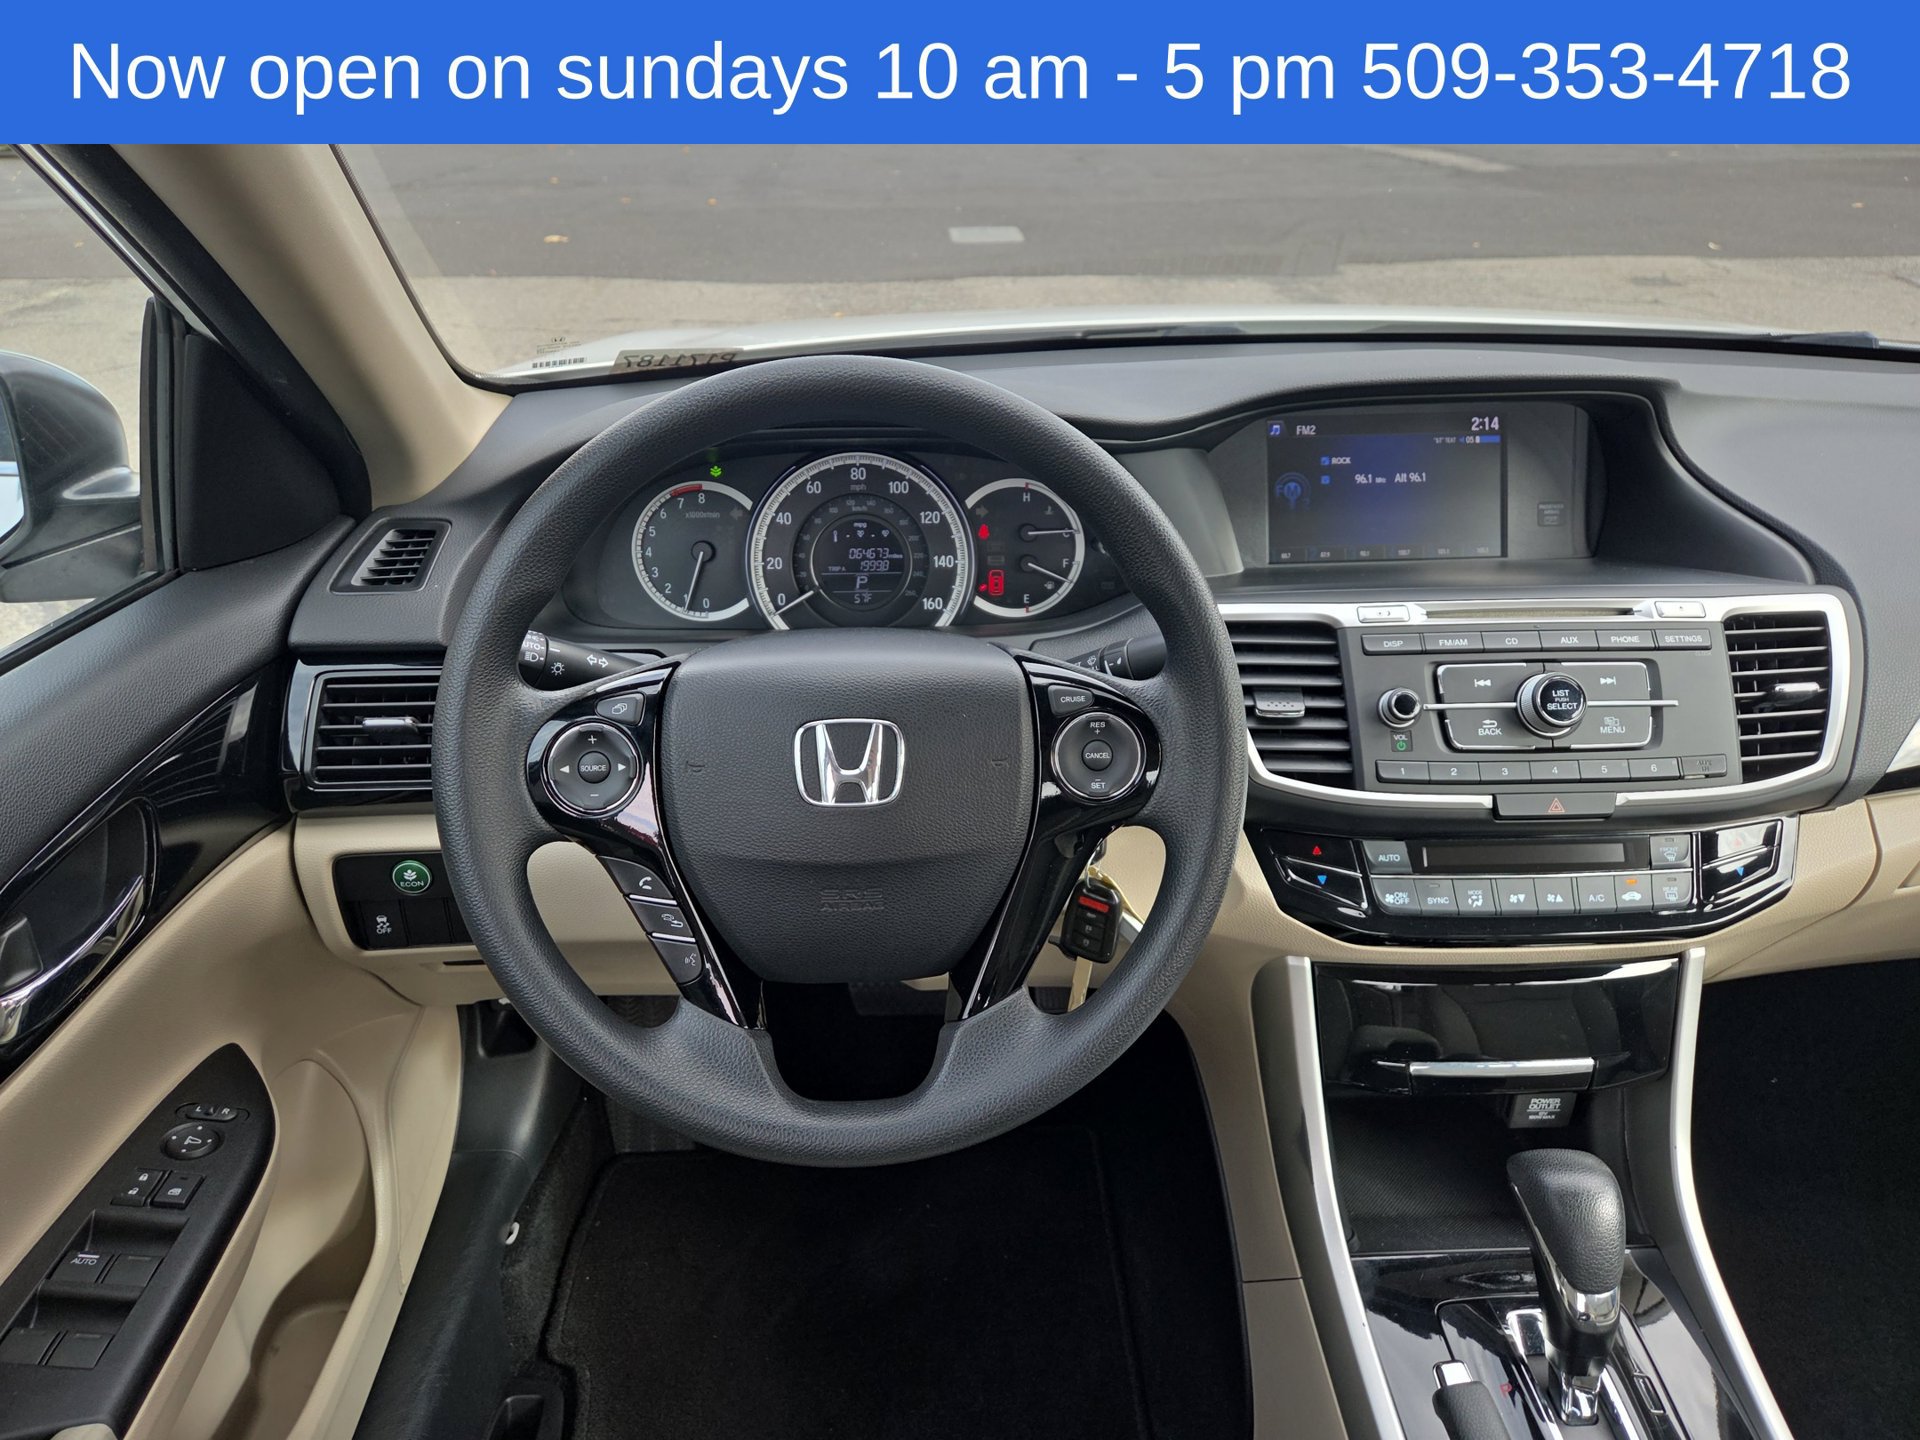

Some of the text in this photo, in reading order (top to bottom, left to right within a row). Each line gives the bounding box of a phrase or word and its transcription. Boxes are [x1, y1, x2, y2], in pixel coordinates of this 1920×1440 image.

[1296, 416, 1499, 436] FM2 2:14
[850, 468, 866, 480] 80
[1355, 474, 1372, 484] 96.1
[1395, 473, 1407, 483] Alt
[1409, 472, 1426, 482] 96.1
[806, 481, 822, 494] 60
[850, 484, 867, 492] mph
[888, 481, 909, 493] 100
[698, 493, 706, 504] 8
[1023, 493, 1030, 502] H
[677, 498, 684, 508] 7
[660, 509, 667, 519] 6
[776, 512, 792, 524] 40
[920, 511, 940, 524] 120
[649, 526, 656, 537] 5
[645, 547, 652, 557] 4
[849, 548, 889, 559] 064673
[766, 558, 782, 570] 20
[933, 555, 954, 568] 140
[1063, 559, 1069, 568] F
[651, 567, 659, 577] 3
[856, 576, 868, 588] P
[664, 583, 672, 593] 2
[703, 598, 710, 608] 0
[778, 594, 786, 606] 0
[923, 597, 943, 610] 160
[1023, 594, 1030, 604] E
[1383, 640, 1403, 648] DISP
[1439, 639, 1468, 647] FM/AM
[1505, 637, 1519, 645] CD
[1560, 636, 1579, 644] AUX
[1665, 635, 1702, 643] SETTINGS
[1547, 702, 1577, 710] SELECT
[1478, 728, 1502, 736] BACK
[1600, 726, 1626, 734] MENU
[1552, 766, 1558, 774] 4
[1601, 765, 1608, 773] 5
[1651, 764, 1658, 772] 6
[1378, 854, 1400, 862] AUTO
[1589, 894, 1605, 902] A/C
[70, 1258, 97, 1266] AUTO
